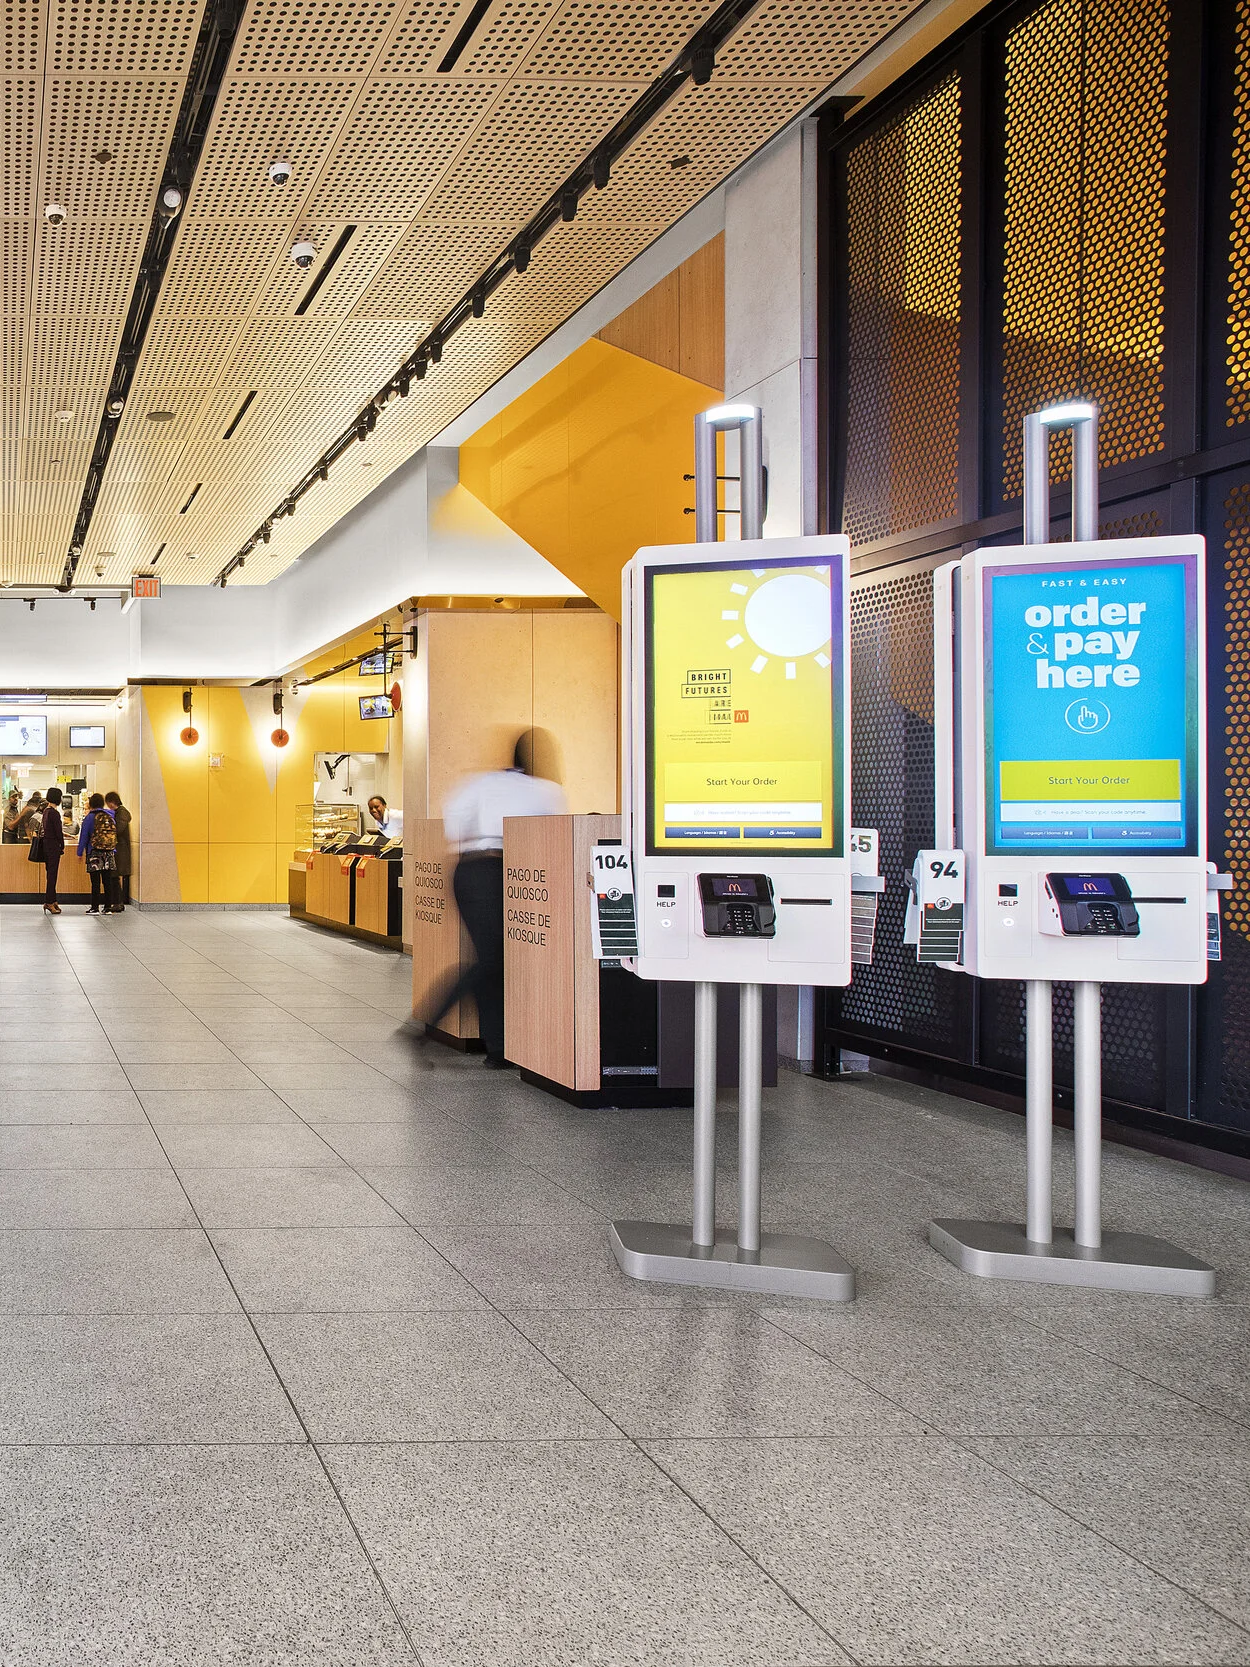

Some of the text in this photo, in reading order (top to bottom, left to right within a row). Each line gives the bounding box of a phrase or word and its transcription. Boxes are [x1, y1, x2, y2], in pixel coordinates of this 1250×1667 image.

[135, 579, 158, 597] EXIT
[1094, 578, 1127, 586] EASY
[1024, 596, 1147, 628] order
[1026, 631, 1141, 661] & pay
[691, 673, 727, 681] BRIGHT
[1036, 658, 1141, 689] here
[685, 686, 728, 695] FUTURES
[706, 777, 778, 786] Start Your Order
[1048, 776, 1130, 785] Start Your Order
[415, 861, 442, 875] PAGO DE
[595, 854, 628, 870] 104
[930, 860, 959, 879] 94
[415, 876, 444, 890] QUIOSCO
[507, 868, 546, 883] PAGO DE
[507, 885, 549, 902] QUIOSCO
[415, 894, 445, 910] CASSE DE
[415, 909, 442, 925] KIOSQUE
[507, 908, 551, 929] CASSE DE
[507, 926, 546, 947] KIOSQUE
